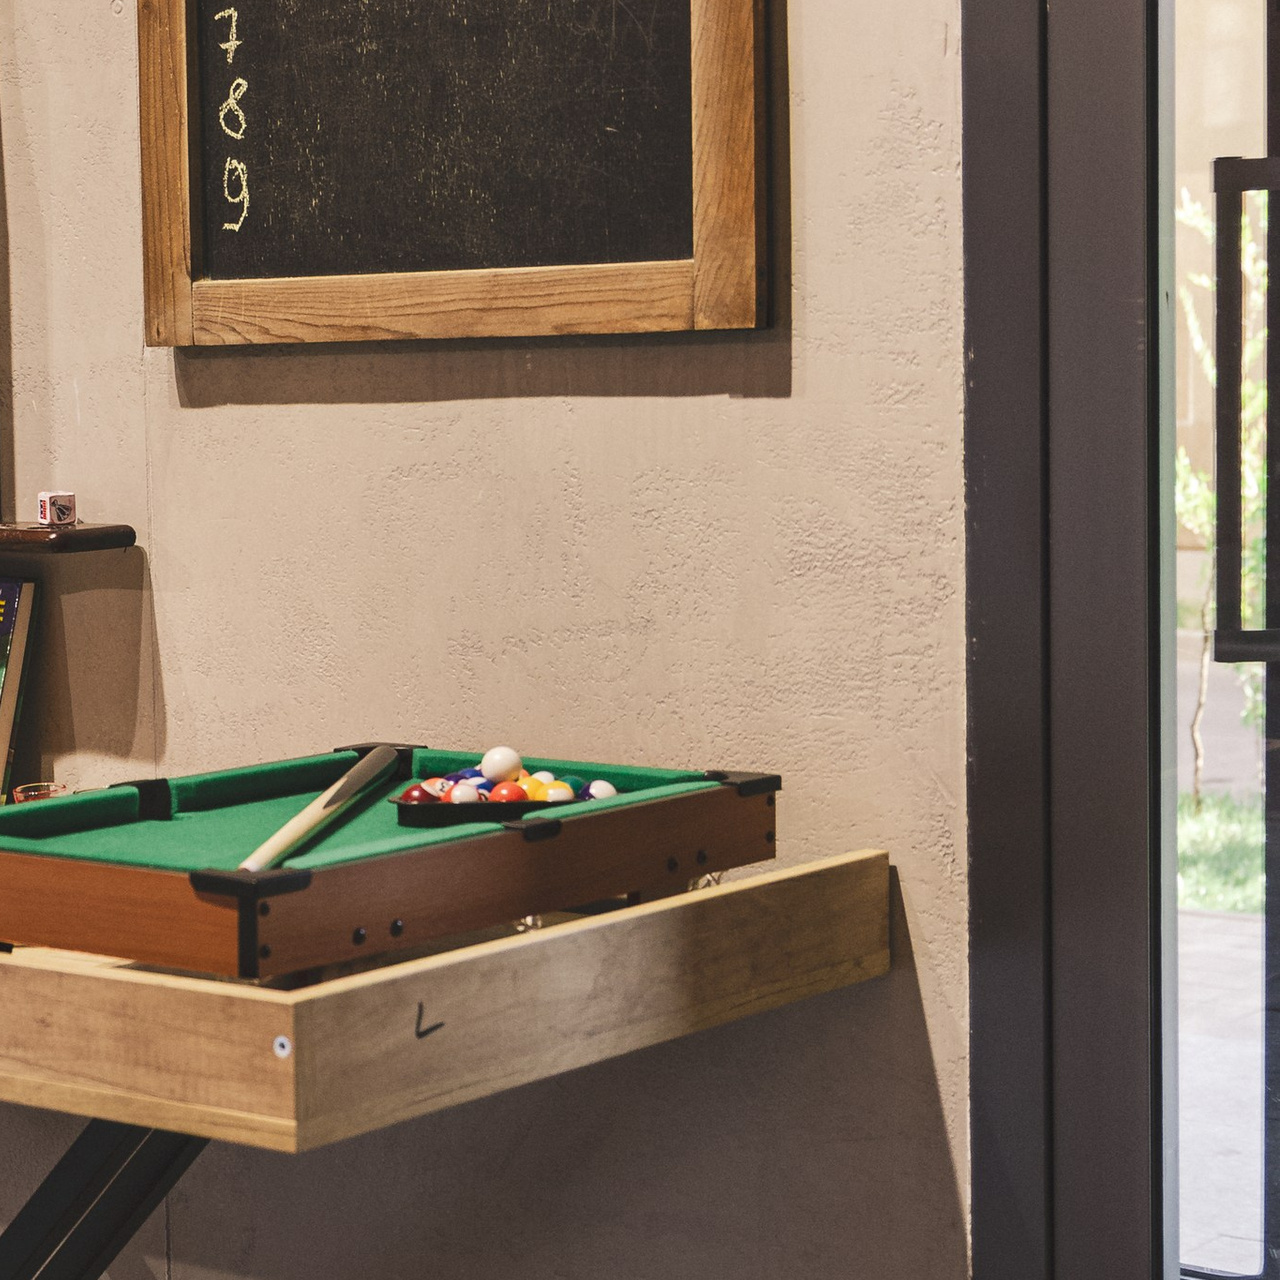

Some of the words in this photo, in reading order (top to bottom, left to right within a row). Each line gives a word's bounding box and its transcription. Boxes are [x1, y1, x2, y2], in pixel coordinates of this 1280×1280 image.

[213, 7, 243, 63] 7
[220, 77, 248, 140] 8
[222, 157, 250, 232] 9
